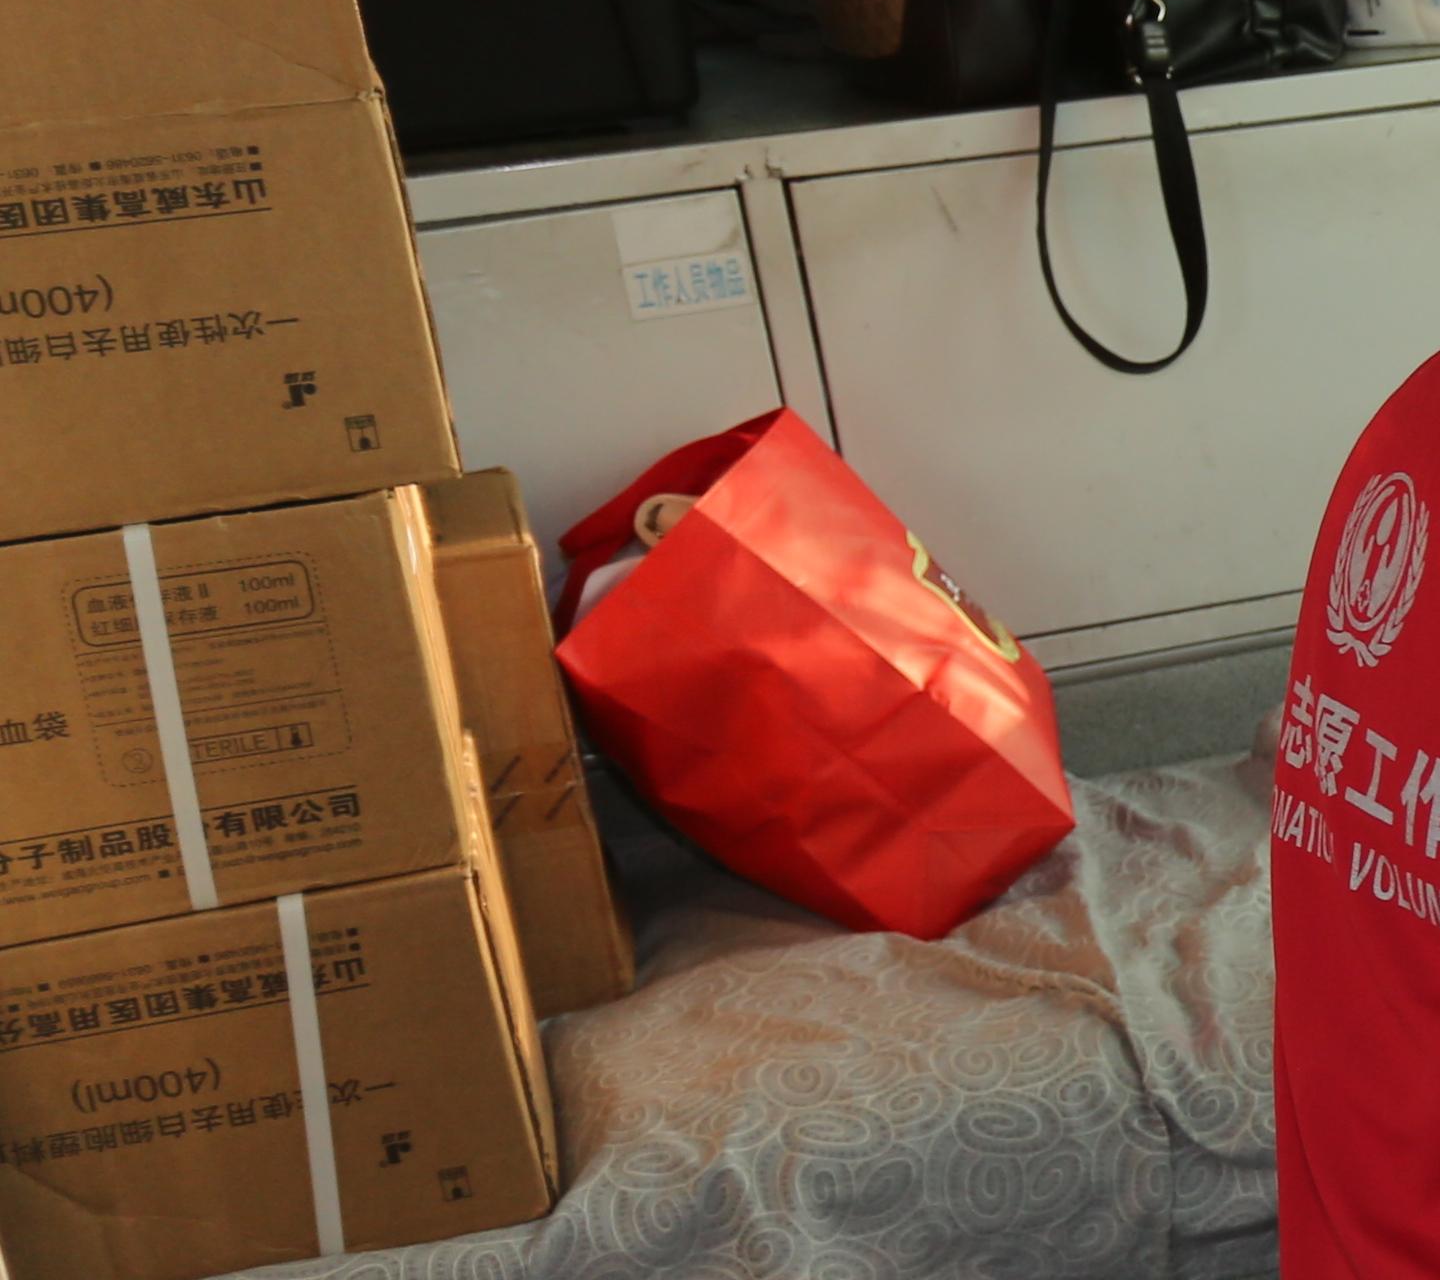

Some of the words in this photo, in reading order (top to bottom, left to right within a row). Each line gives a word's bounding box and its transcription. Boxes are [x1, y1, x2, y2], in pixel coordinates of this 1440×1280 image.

[0, 310, 300, 368] 一次性使用去白细
[190, 733, 269, 757] TERILE
[71, 1056, 222, 1115] (400ml)
